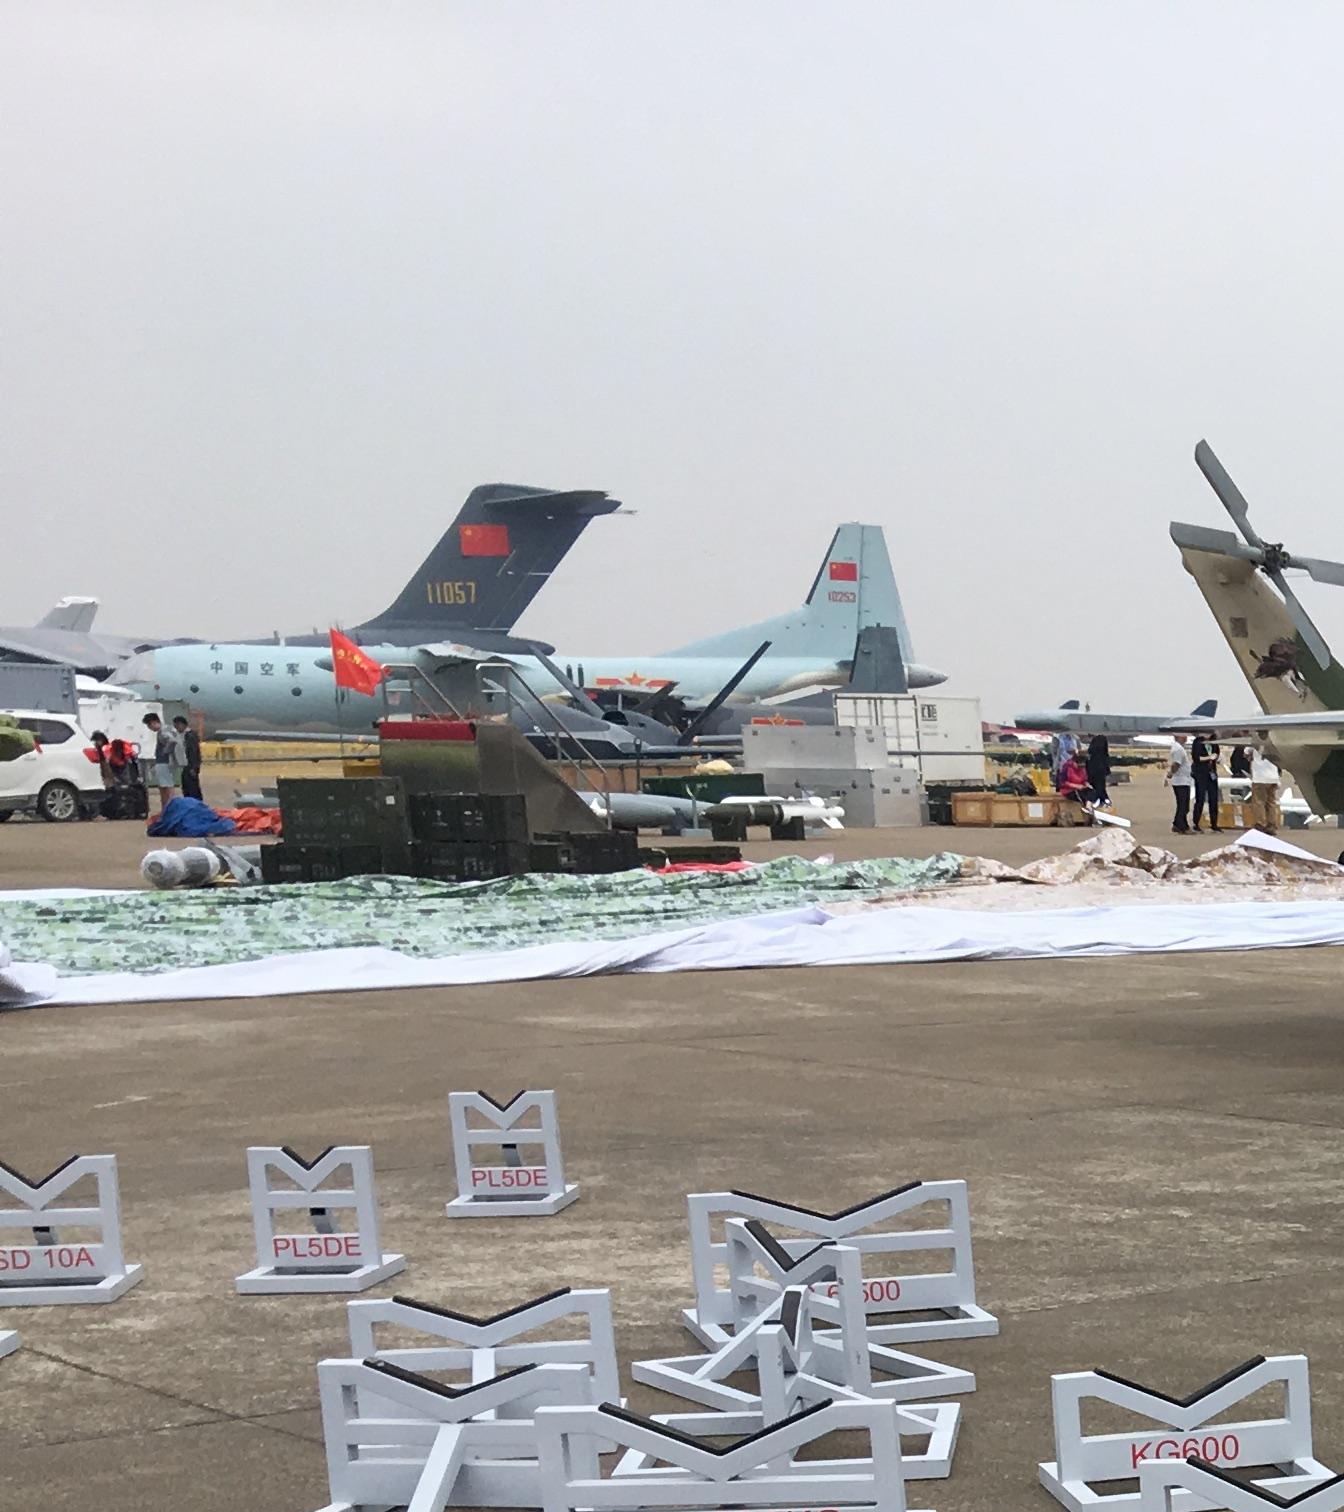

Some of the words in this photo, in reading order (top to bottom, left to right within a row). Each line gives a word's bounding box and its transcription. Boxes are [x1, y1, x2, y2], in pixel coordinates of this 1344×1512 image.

[426, 581, 477, 605] 11057
[210, 660, 301, 677] 中国空军
[471, 1168, 548, 1188] PL5DE
[43, 1246, 95, 1269] 10A
[273, 1236, 362, 1258] PL5DE
[1131, 1434, 1240, 1469] KG600
